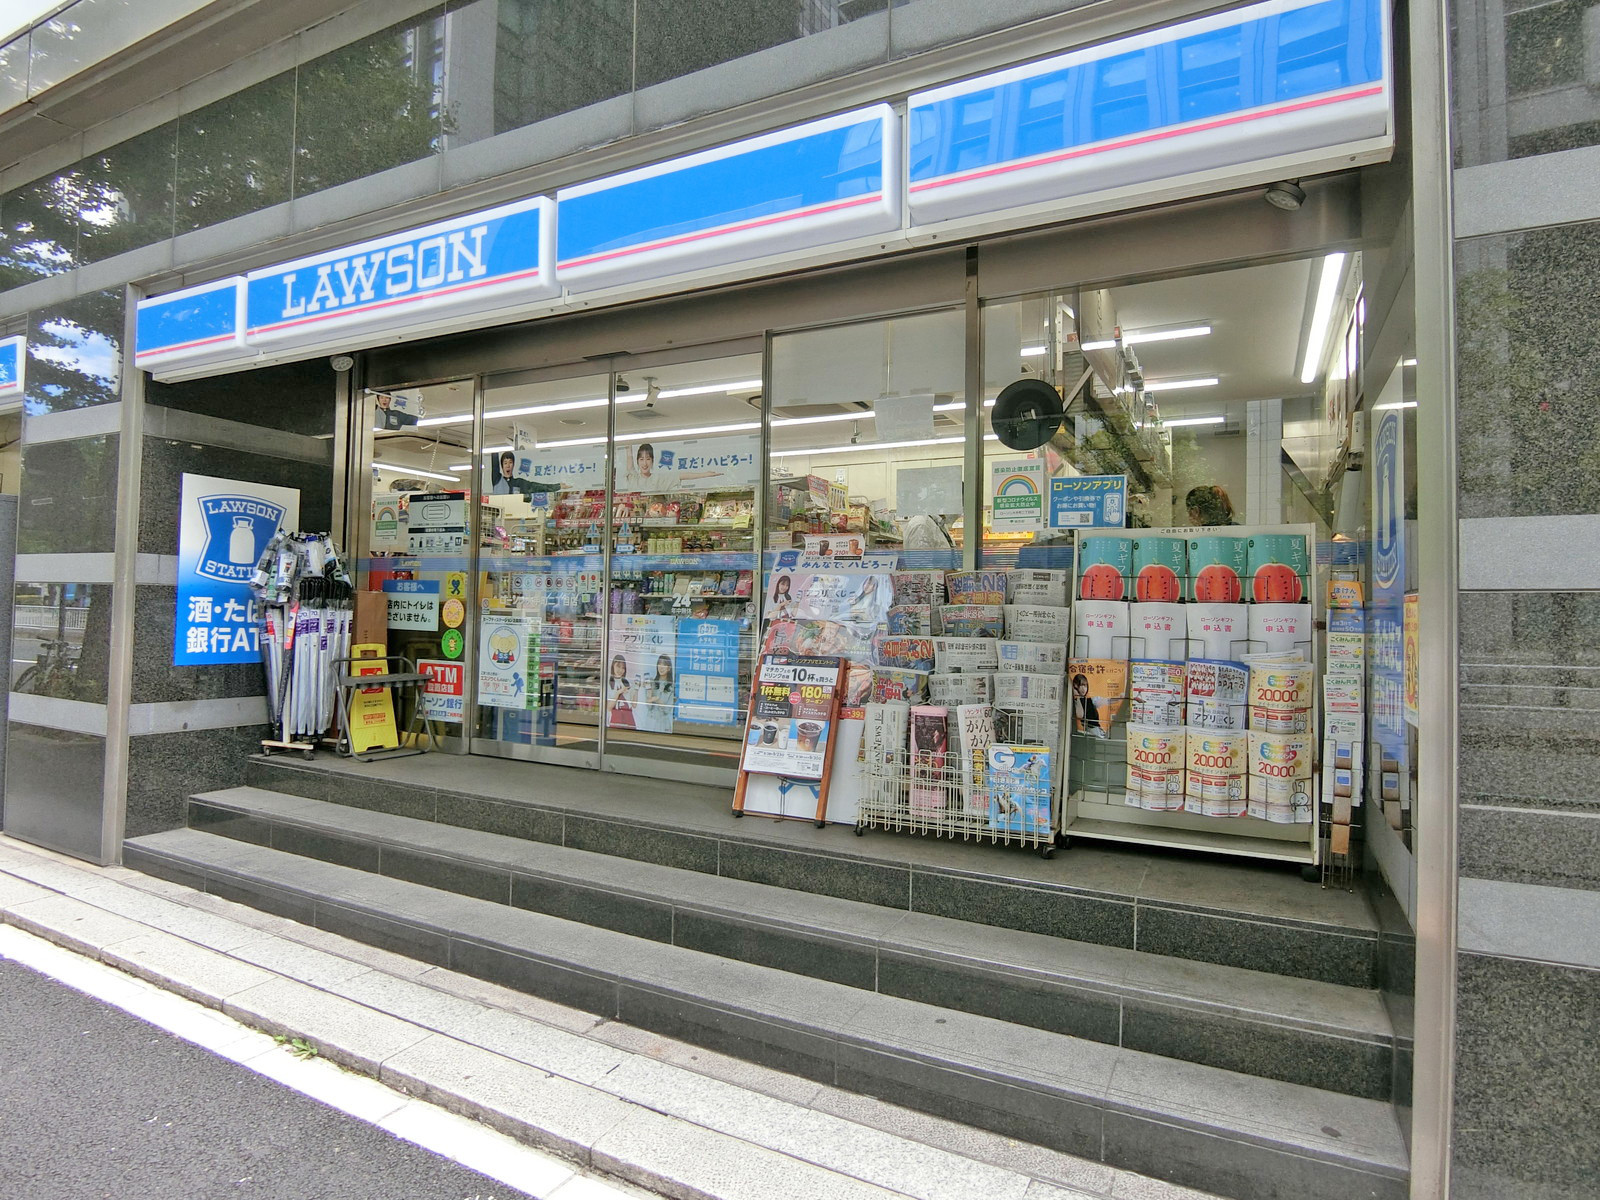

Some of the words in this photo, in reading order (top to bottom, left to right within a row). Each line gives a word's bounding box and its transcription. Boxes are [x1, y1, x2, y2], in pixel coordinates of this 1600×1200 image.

[282, 225, 488, 318] LAWSON
[1053, 479, 1122, 492] ローソンアプリ
[207, 501, 279, 522] LAWSON
[205, 560, 258, 579] STATI
[396, 582, 425, 591] お客様へ
[672, 593, 691, 608] 24
[1087, 620, 1114, 628] 申込書
[1145, 622, 1172, 631] 申込書
[1203, 624, 1232, 632] 申込書
[1265, 625, 1296, 633] 申込書
[186, 627, 260, 653] 銀行AT
[425, 665, 458, 684] ATM
